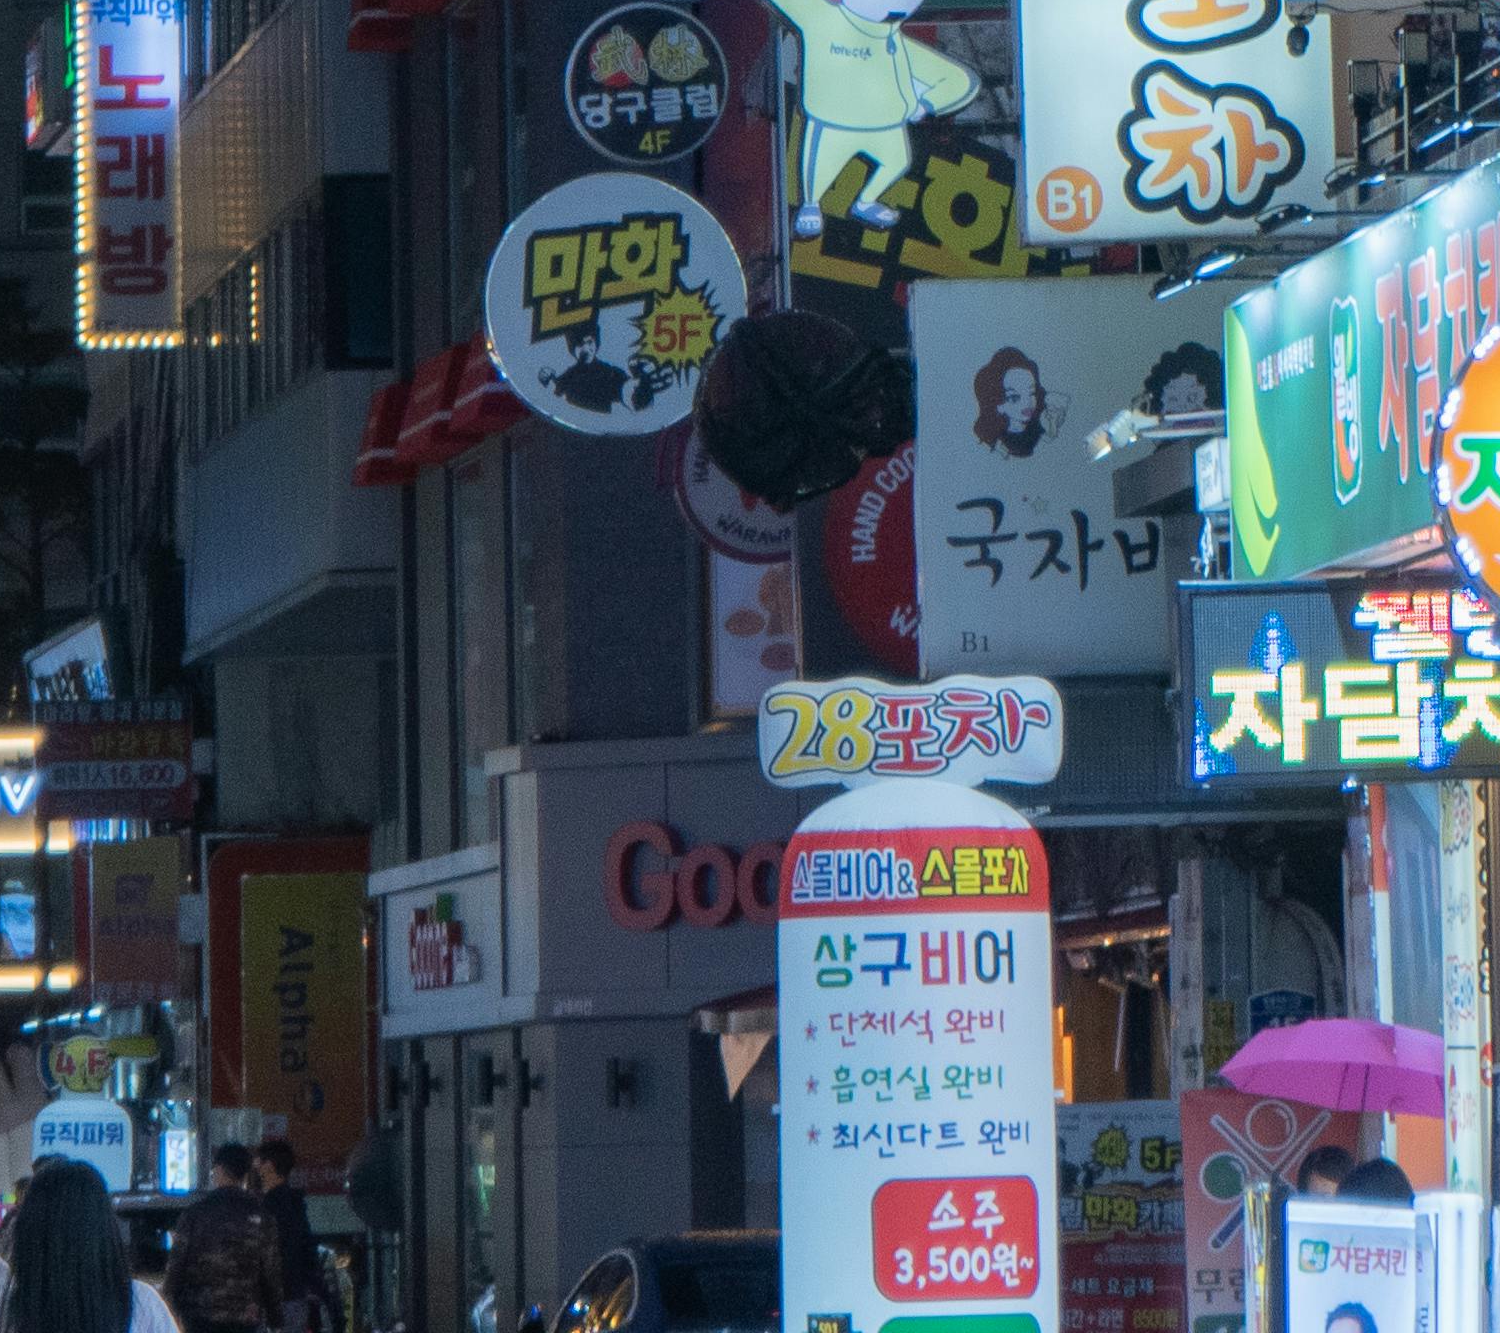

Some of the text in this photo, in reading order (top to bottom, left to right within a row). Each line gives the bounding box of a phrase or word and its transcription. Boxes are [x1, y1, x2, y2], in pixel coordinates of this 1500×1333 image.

[637, 128, 671, 155] 4F
[97, 44, 173, 297] 노래방
[1045, 178, 1100, 221] B1
[524, 210, 688, 341] 만화
[651, 312, 706, 355] 5F
[850, 489, 886, 565] HAND
[959, 629, 992, 654] B1
[767, 690, 1051, 777] 28포차
[921, 843, 1031, 900] 스몰포차
[812, 929, 1017, 988] 상구비어
[278, 924, 315, 1073] Alpha
[828, 1007, 1006, 1049] 단체석 완비
[830, 1064, 1005, 1104] 흡연실 완비
[38, 1121, 125, 1148] 뮤직파워
[831, 1120, 1031, 1158] 최신다트 완비
[928, 1189, 1006, 1239] 소주
[1329, 1244, 1408, 1277] 자담치킨
